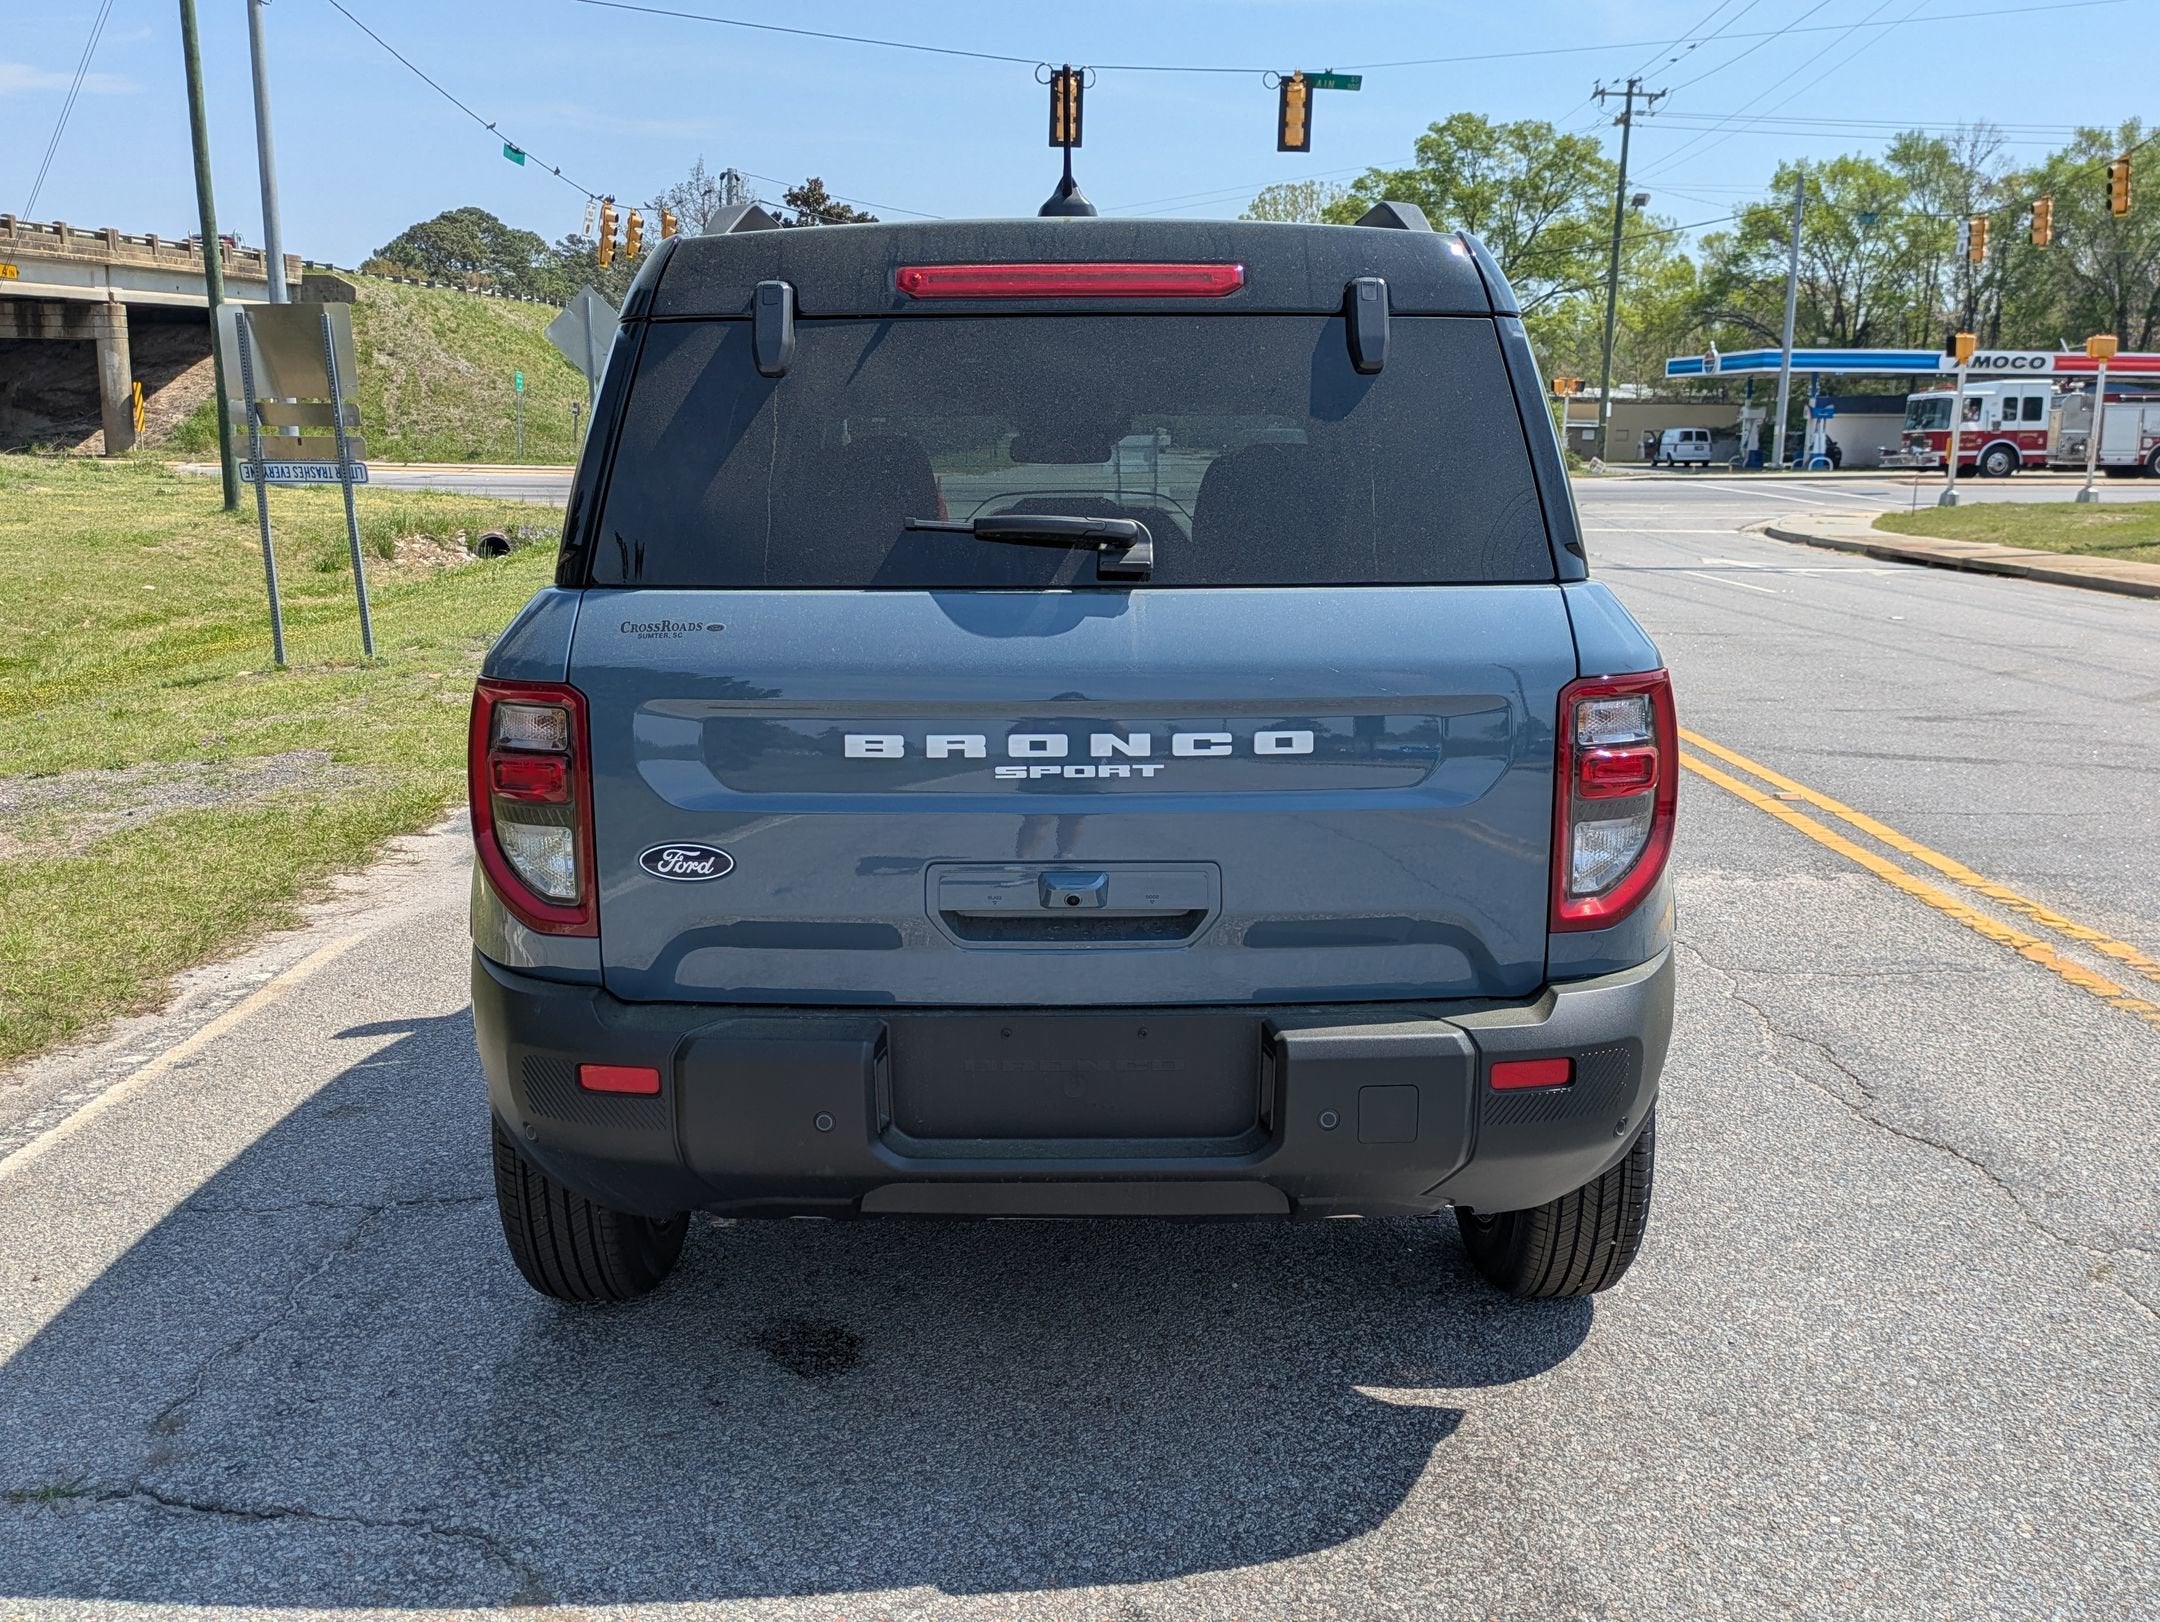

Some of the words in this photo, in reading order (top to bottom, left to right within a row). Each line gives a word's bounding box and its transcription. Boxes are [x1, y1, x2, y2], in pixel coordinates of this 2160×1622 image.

[1314, 79, 1336, 89] AIN
[244, 465, 290, 479] EVERYNE
[294, 465, 334, 480] TRASHES
[335, 466, 364, 480] LITR
[844, 731, 1314, 759] BRONCO
[994, 764, 1165, 779] SPORT
[657, 849, 716, 874] Ford
